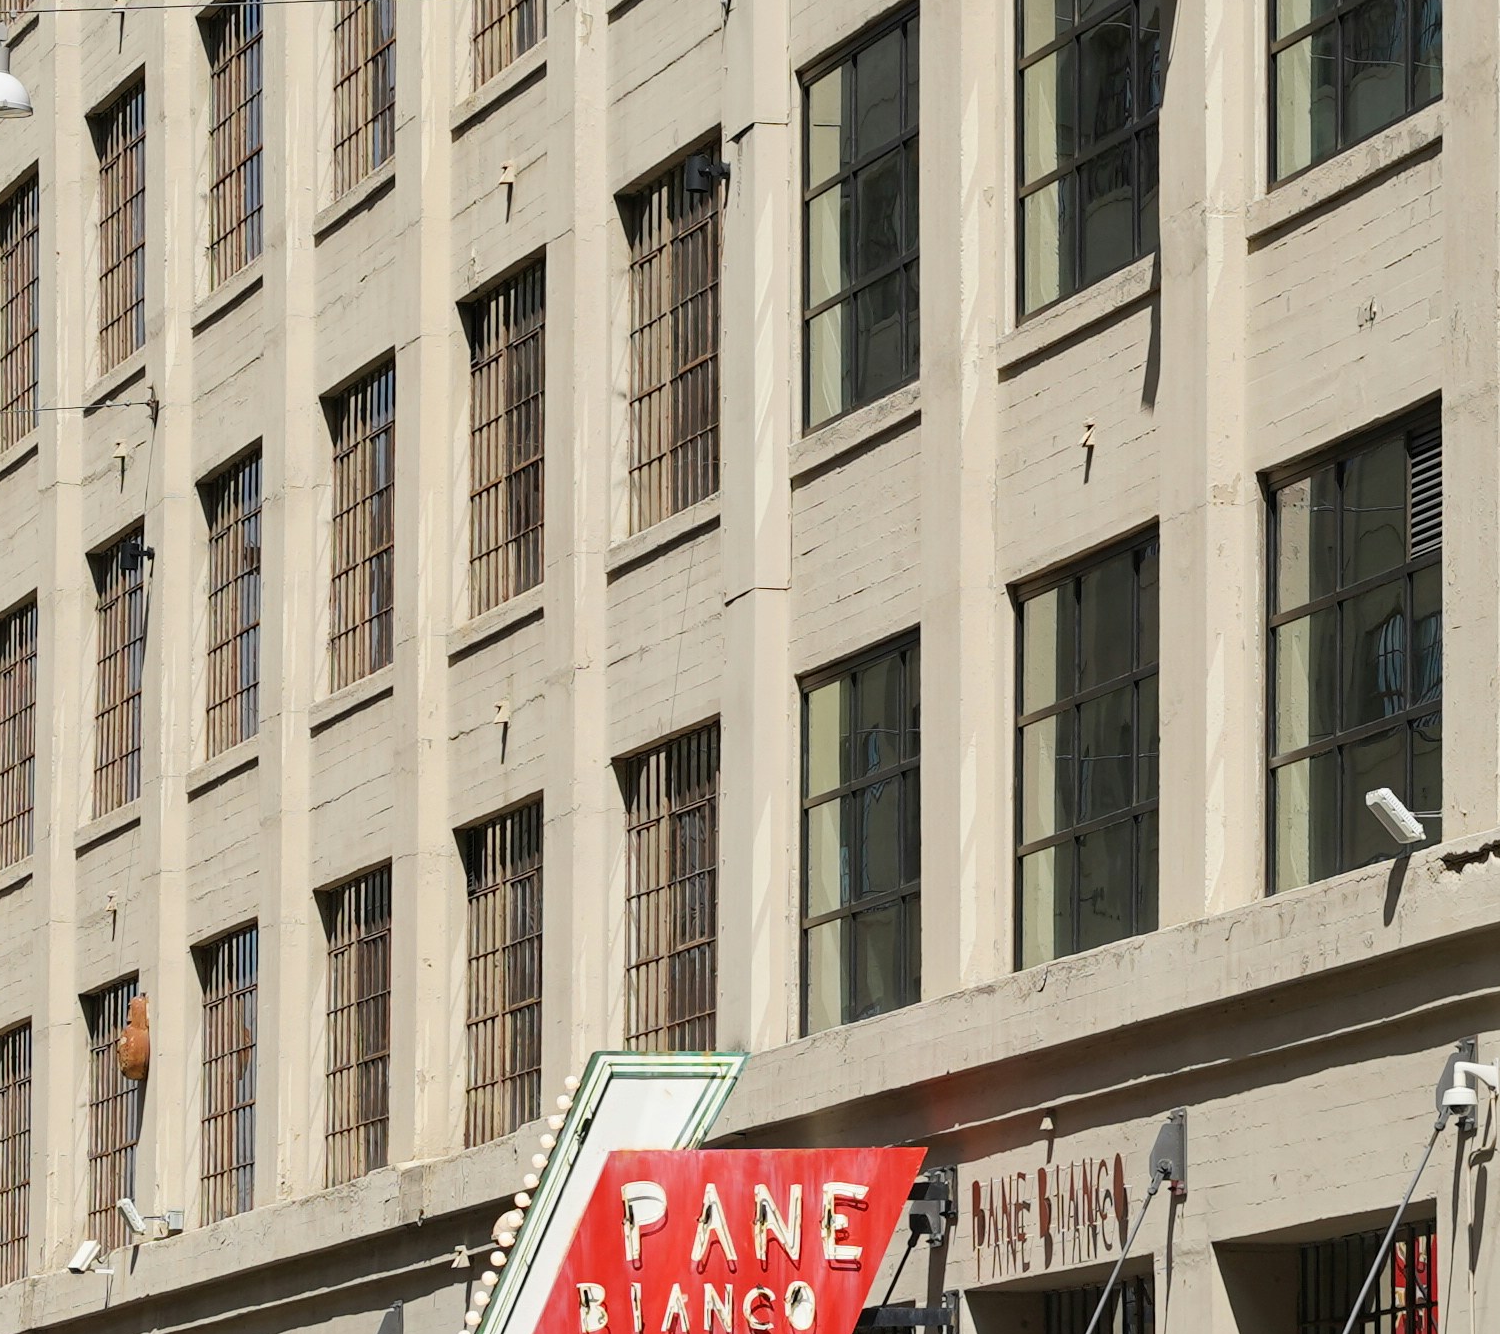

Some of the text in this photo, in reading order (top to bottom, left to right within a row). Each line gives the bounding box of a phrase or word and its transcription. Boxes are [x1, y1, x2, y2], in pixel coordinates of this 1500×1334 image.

[620, 1181, 870, 1262] PANE
[971, 1152, 1125, 1252] PANE BIANCO
[575, 1280, 816, 1334] BIANCO
